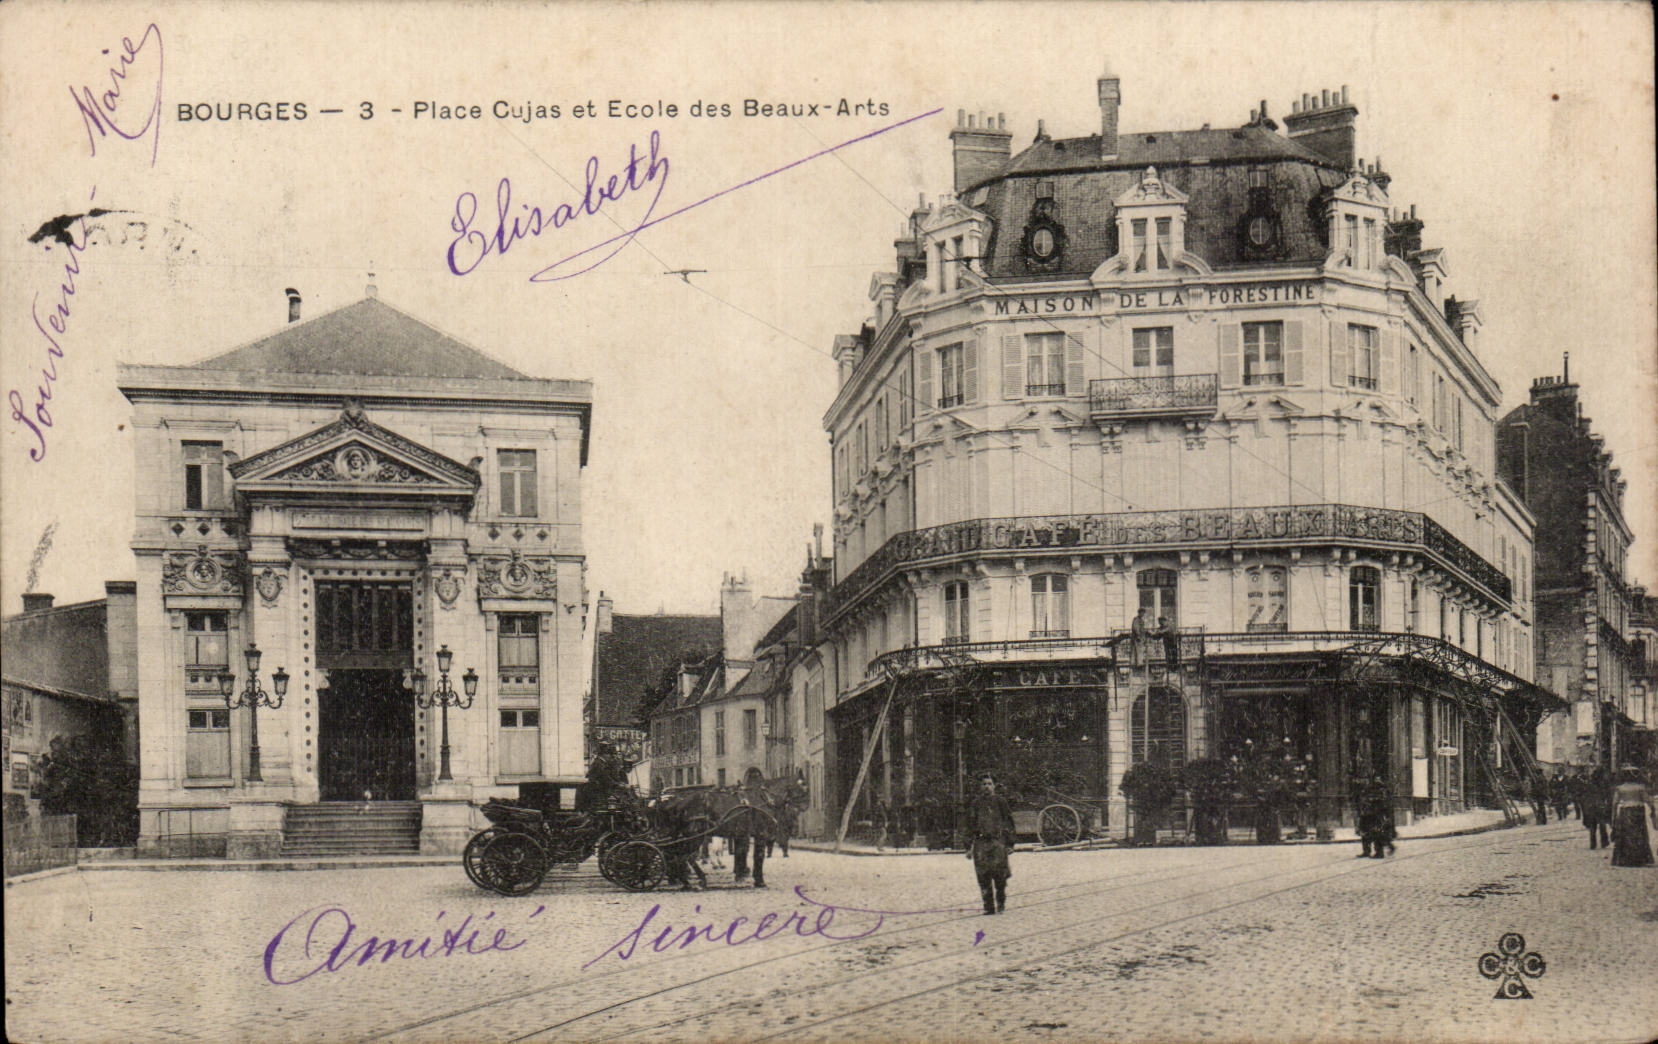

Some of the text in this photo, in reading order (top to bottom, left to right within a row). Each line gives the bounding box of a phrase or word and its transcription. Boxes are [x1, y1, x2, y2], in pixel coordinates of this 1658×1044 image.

[69, 23, 164, 168] Marie
[447, 130, 672, 281] Elisabeth
[994, 285, 1316, 316] MAISON DE LA FORESTINE
[991, 516, 1099, 548] CAFÉ
[1177, 510, 1325, 542] BEAUX
[263, 903, 546, 985] Amitié
